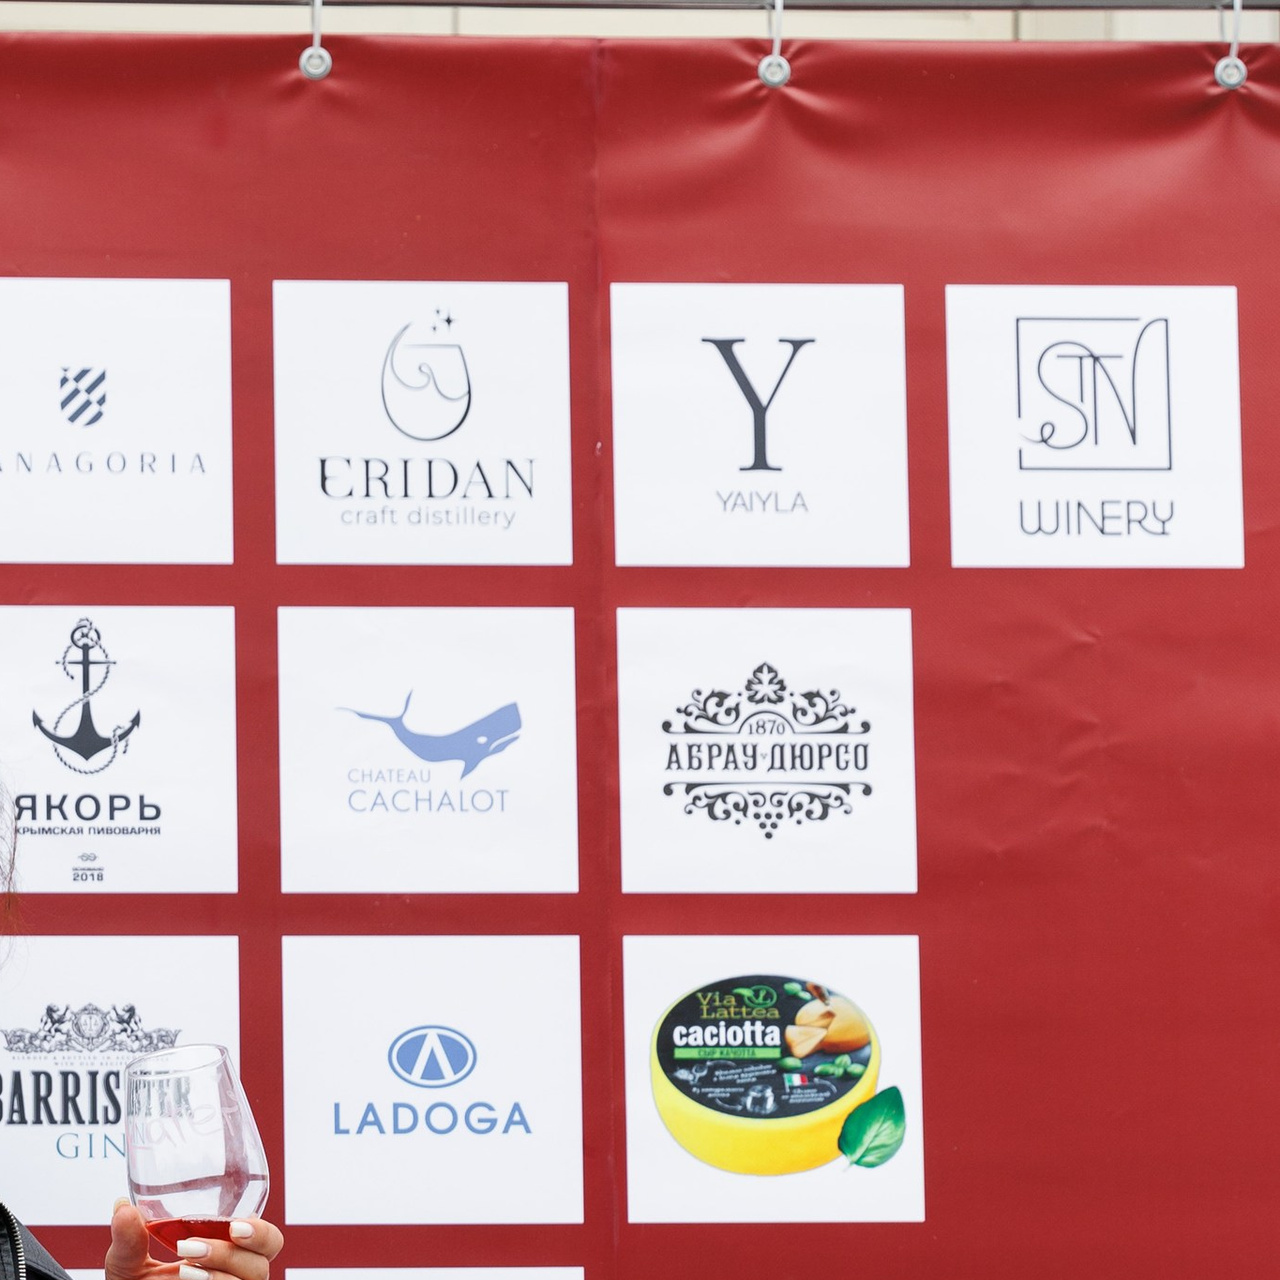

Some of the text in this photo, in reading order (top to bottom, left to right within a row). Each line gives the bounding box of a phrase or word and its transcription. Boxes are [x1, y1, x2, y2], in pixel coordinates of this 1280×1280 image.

[701, 337, 816, 472] Y
[318, 457, 536, 499] ERIDAN
[716, 490, 809, 514] YAIYLA
[340, 506, 516, 529] craft distillery
[1020, 500, 1174, 536] WINERY
[748, 719, 785, 735] 1870
[347, 768, 431, 784] CHATEAU
[15, 794, 162, 821] ЯКОРЬ
[347, 789, 509, 813] CACHALOT
[88, 826, 161, 836] ПИВОВАРНЯ
[72, 872, 104, 882] 2018
[696, 992, 737, 1006] Via
[700, 1005, 780, 1019] Lattea
[673, 1021, 781, 1046] caciotta
[334, 1102, 532, 1135] LADOGA
[56, 1132, 127, 1159] GIN
